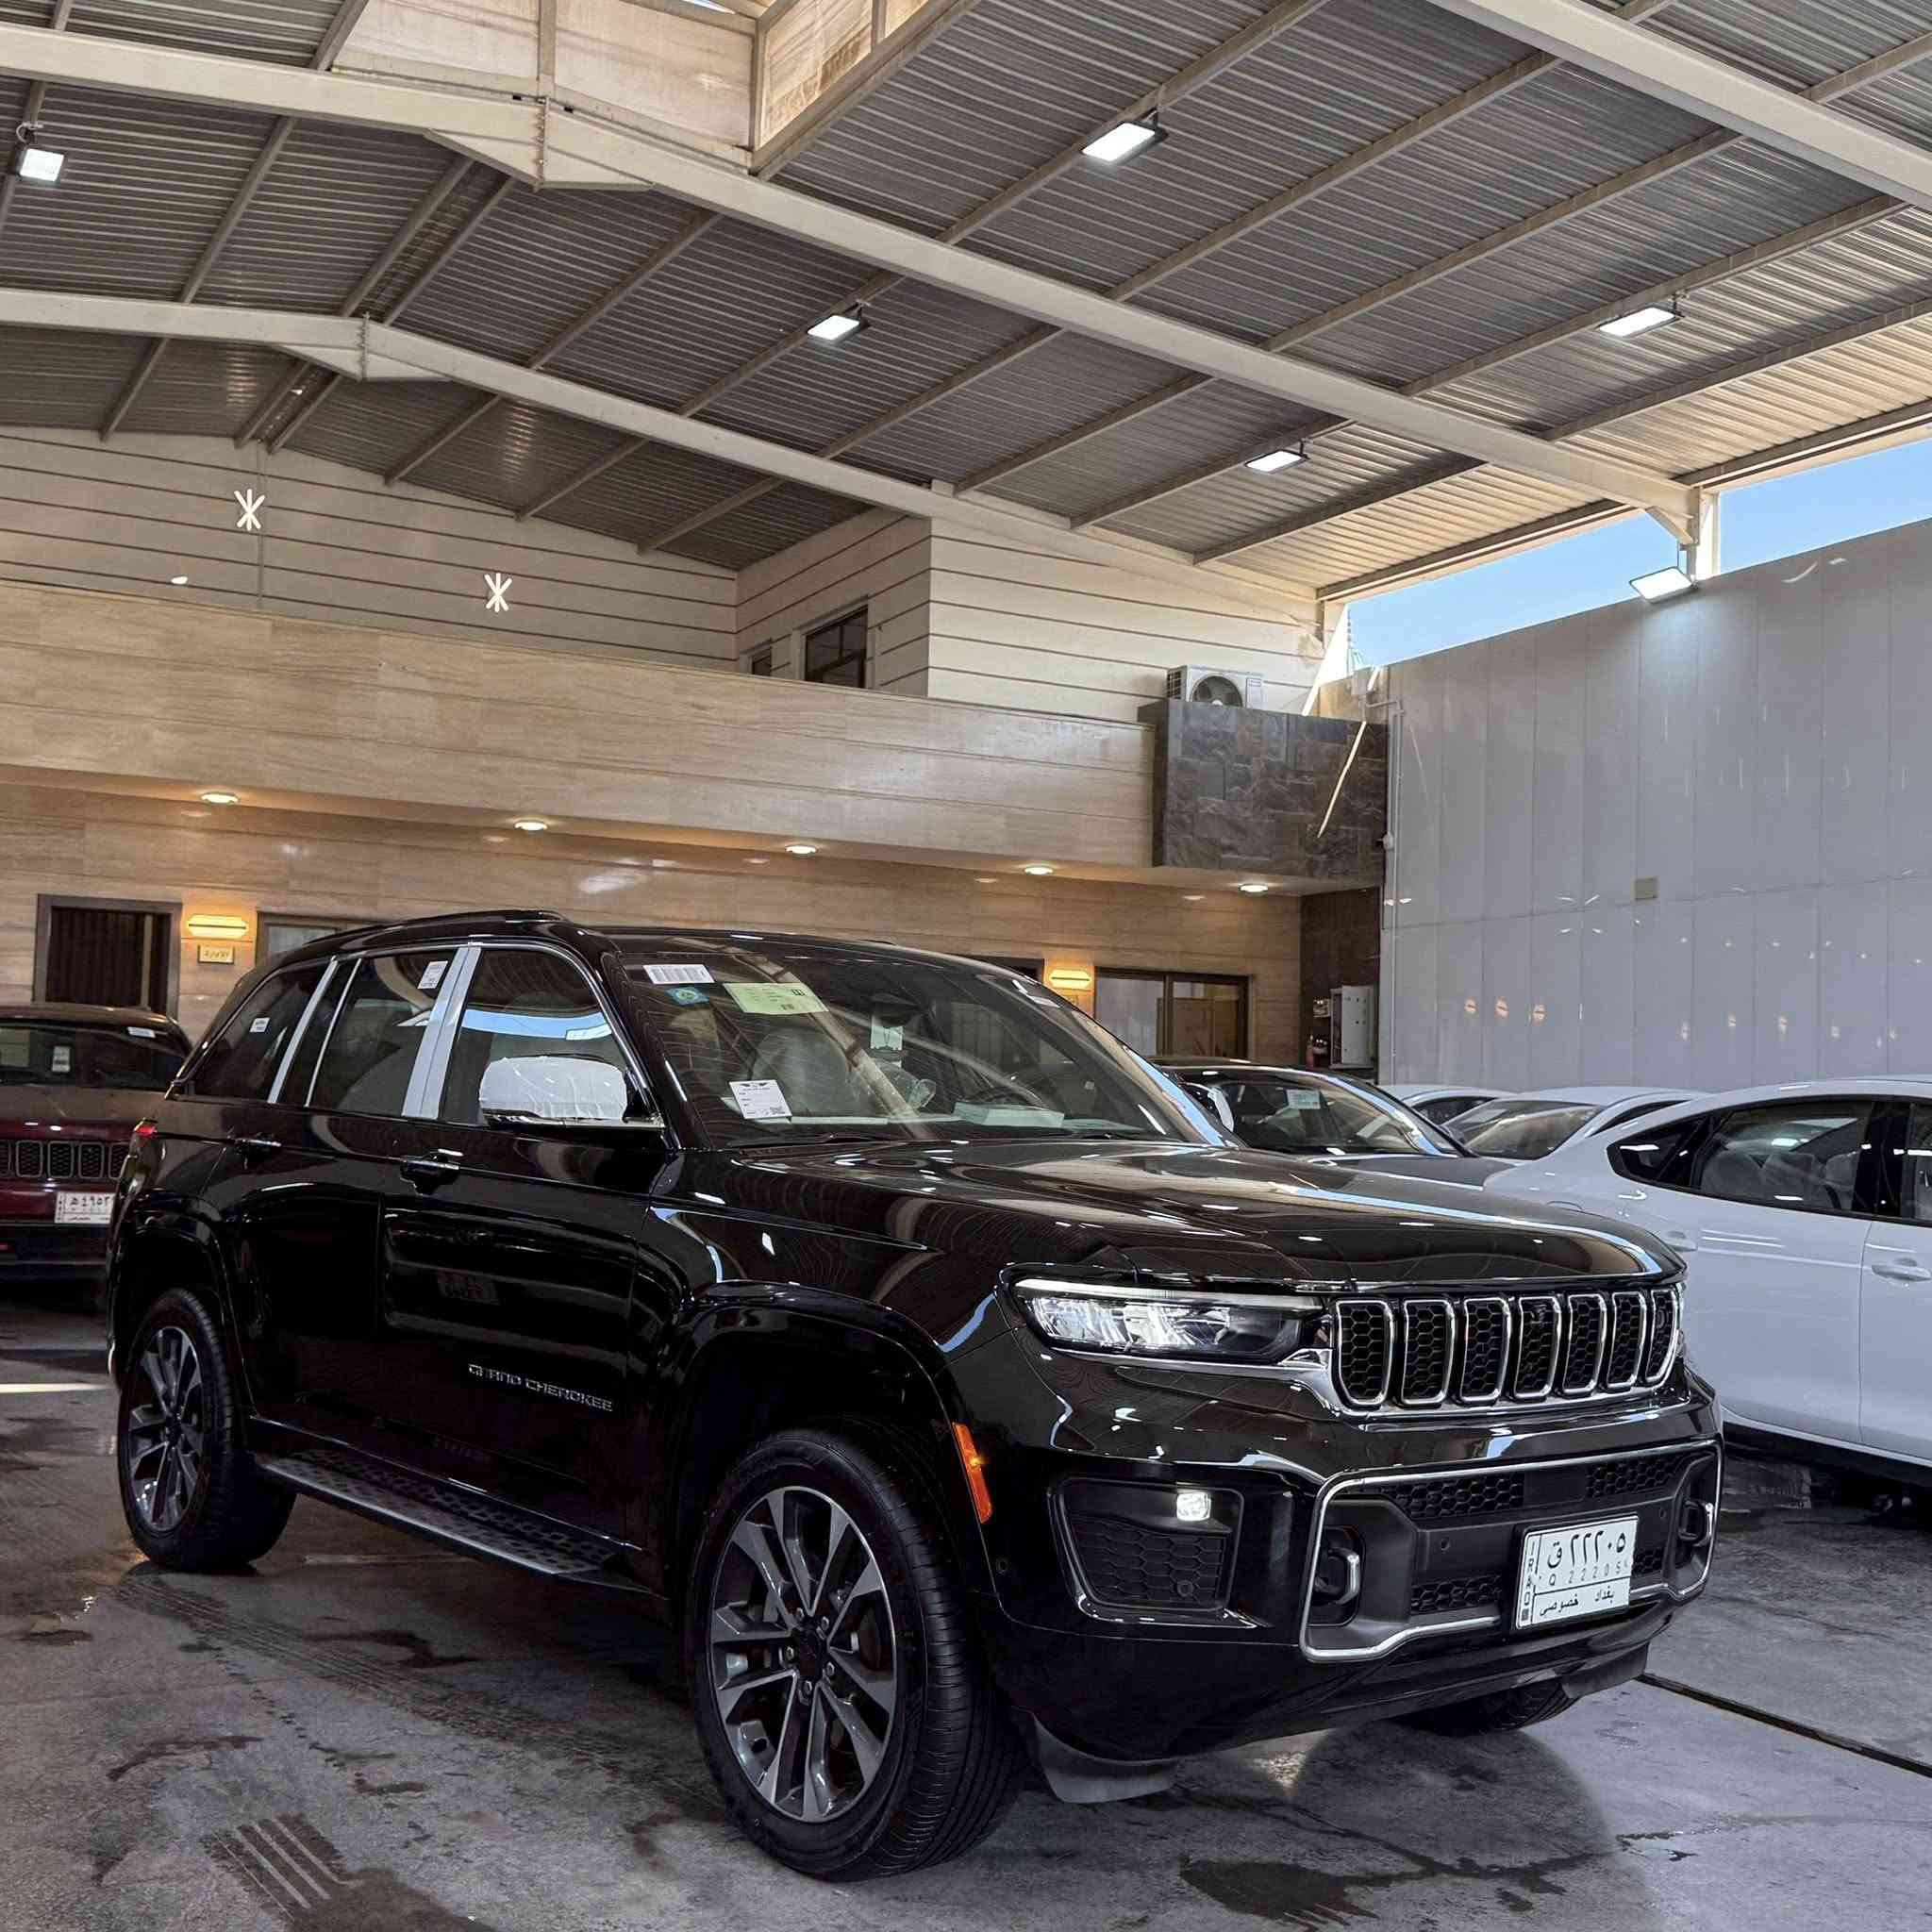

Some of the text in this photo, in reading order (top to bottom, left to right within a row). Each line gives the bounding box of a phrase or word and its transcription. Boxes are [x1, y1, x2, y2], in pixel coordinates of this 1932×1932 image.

[525, 1377, 613, 1412] CHEROKEE
[1524, 1541, 1536, 1607] IRAQ
[1568, 1560, 1622, 1584] 22205
[1539, 1585, 1615, 1617] بغداد خصوصي
